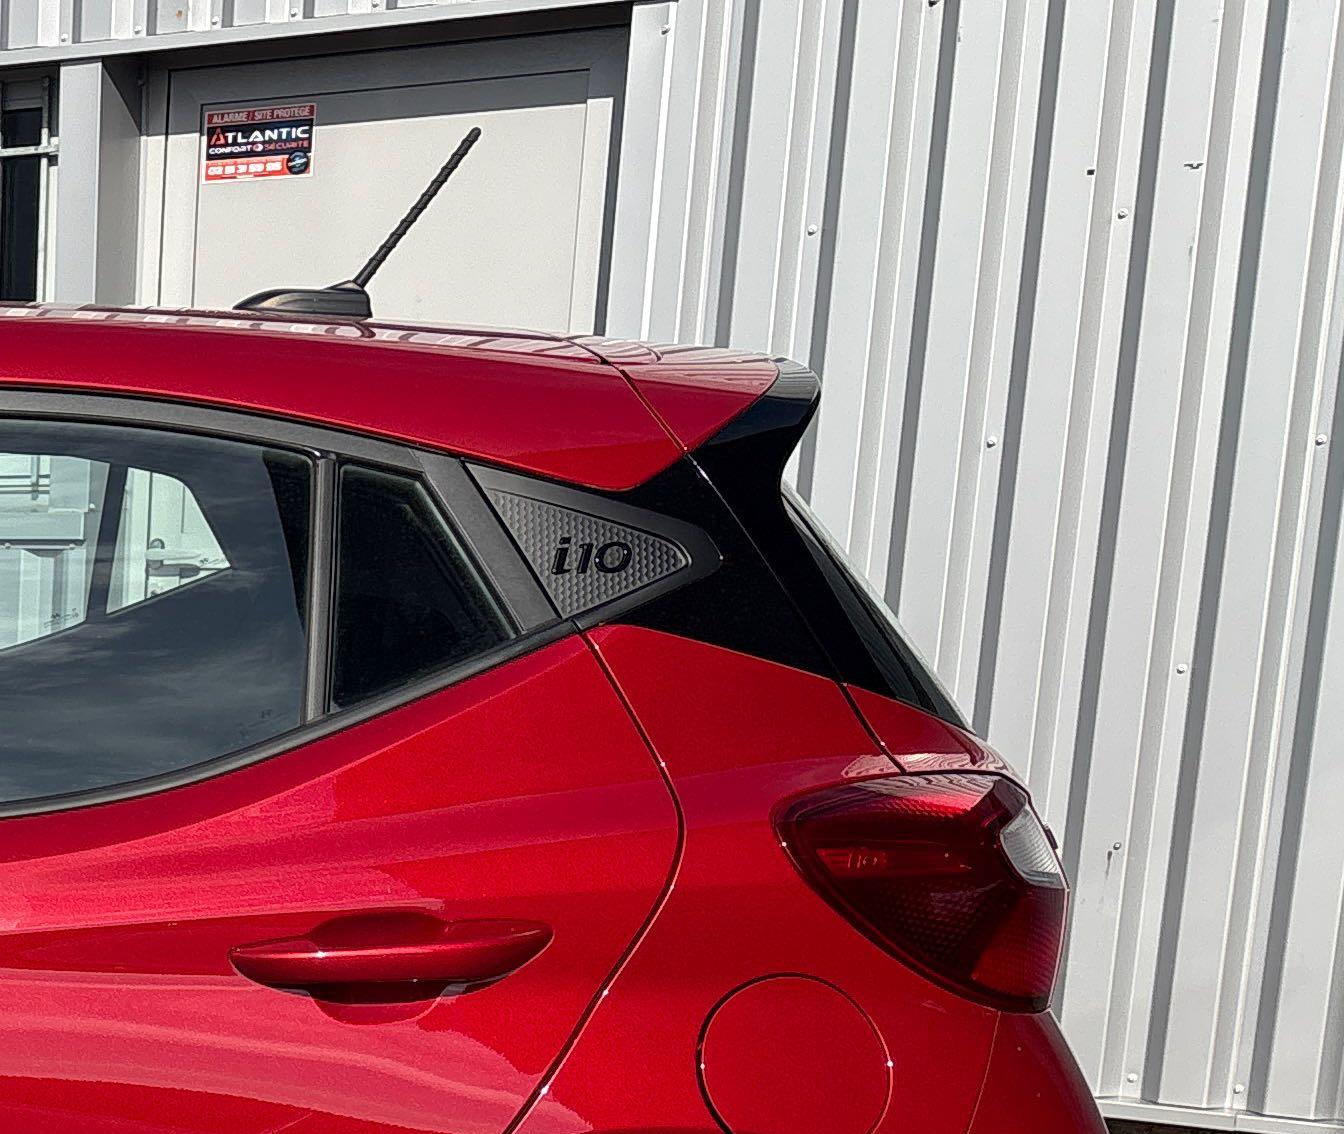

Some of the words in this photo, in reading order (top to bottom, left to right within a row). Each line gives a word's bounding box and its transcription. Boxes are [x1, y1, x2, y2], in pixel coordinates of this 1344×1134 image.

[254, 109, 272, 121] SITE
[210, 126, 310, 146] ATLANTIC
[551, 536, 633, 576] i10
